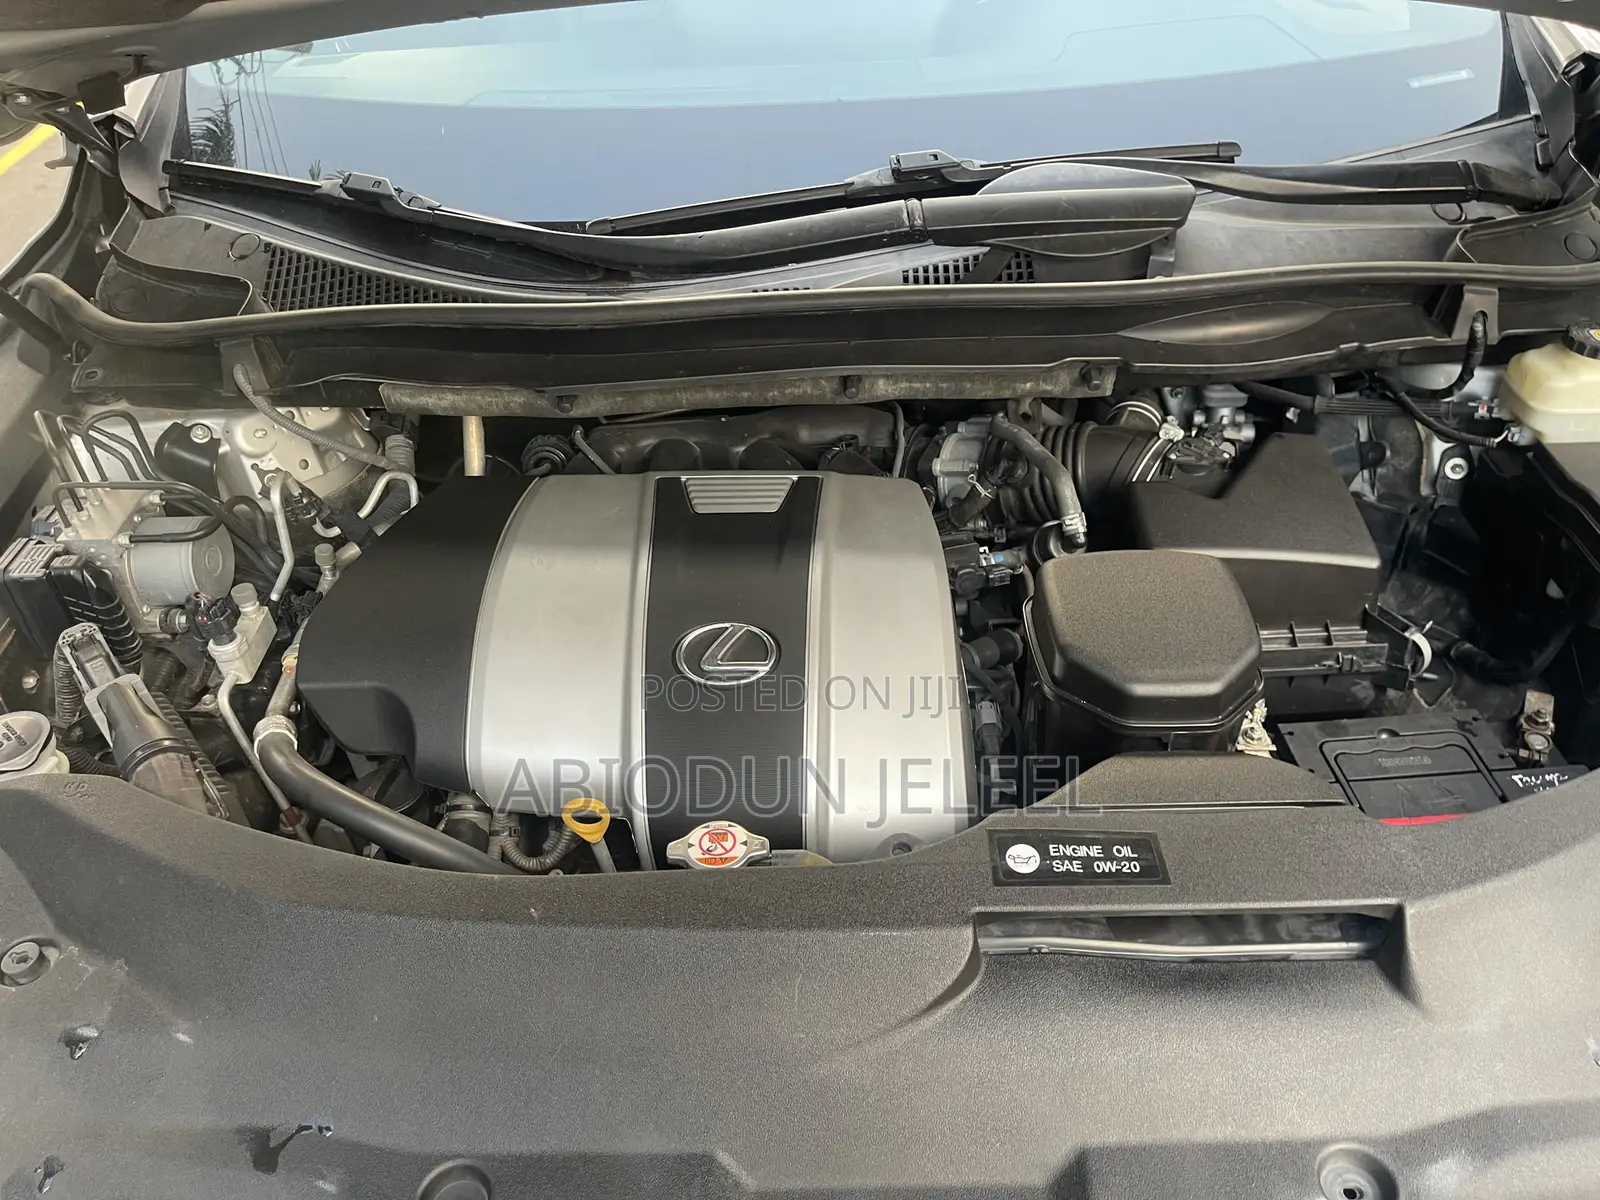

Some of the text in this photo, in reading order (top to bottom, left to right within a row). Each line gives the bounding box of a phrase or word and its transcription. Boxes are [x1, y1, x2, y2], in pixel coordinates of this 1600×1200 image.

[1048, 844, 1139, 857] ENGINE OIL
[1052, 860, 1140, 873] SAE 0W-20
